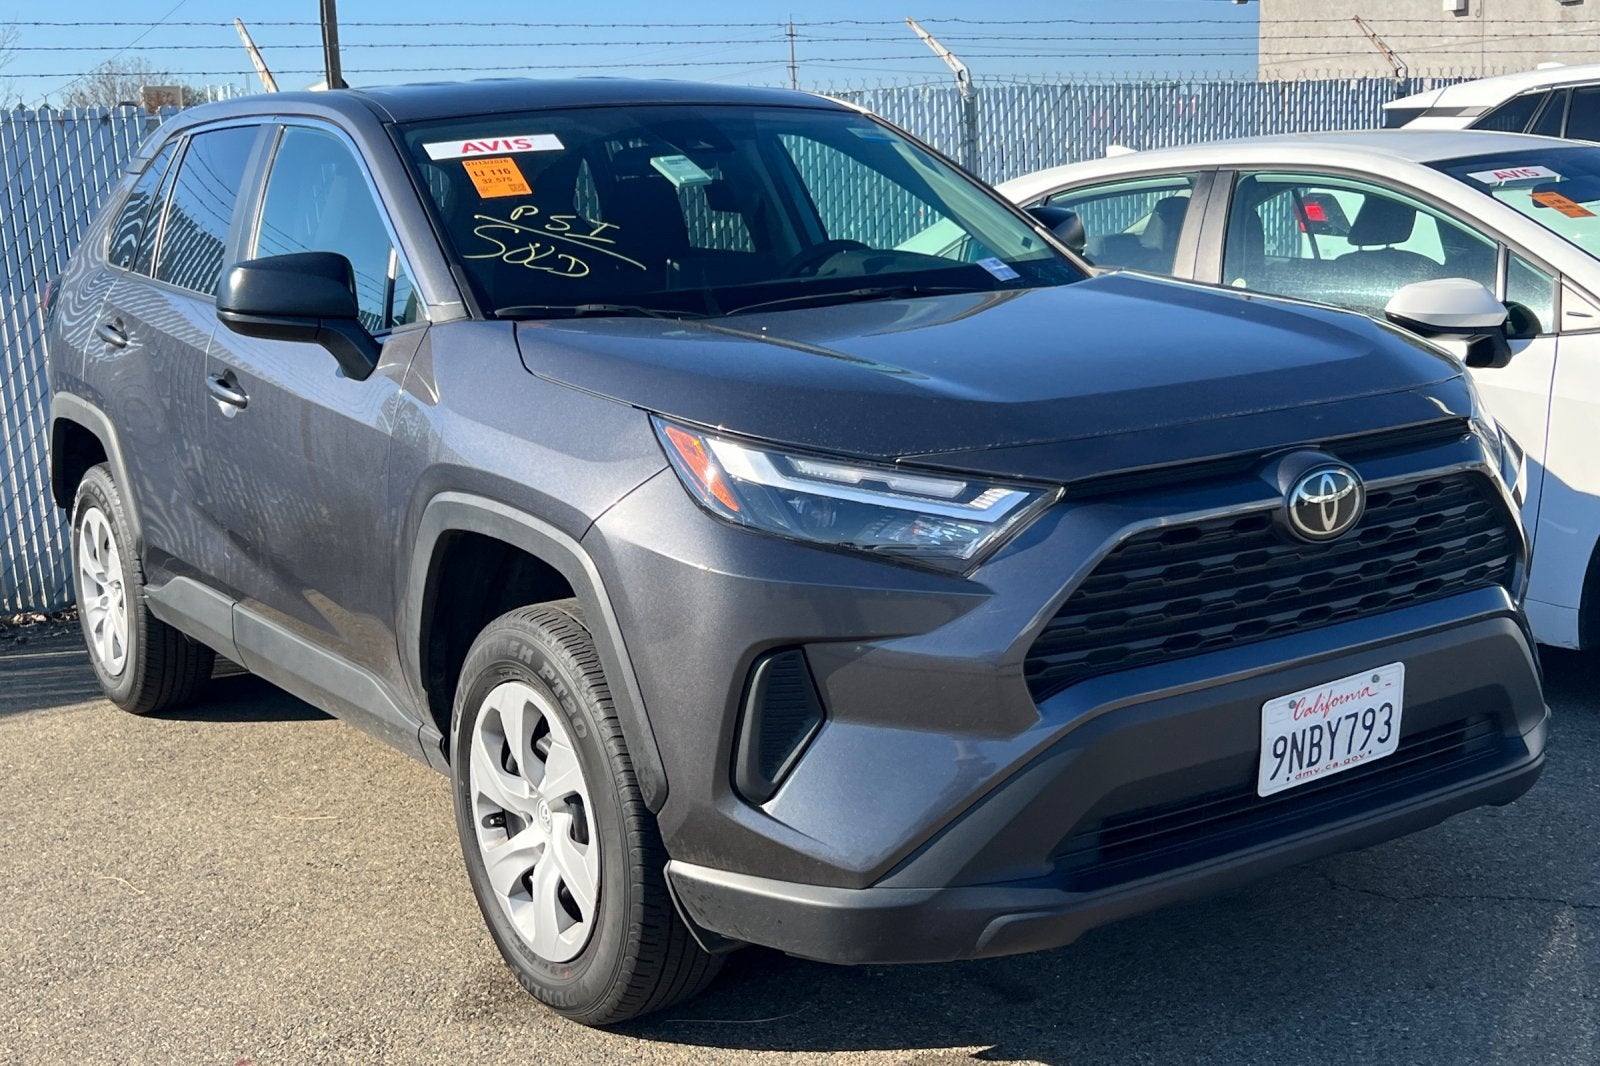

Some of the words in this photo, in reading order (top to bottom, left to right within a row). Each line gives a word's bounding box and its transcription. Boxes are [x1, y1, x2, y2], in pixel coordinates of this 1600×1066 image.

[462, 138, 532, 153] AVIS
[1493, 169, 1540, 179] AVIS
[463, 224, 590, 277] SOLD
[1294, 686, 1378, 720] California
[1269, 702, 1393, 781] 9NBY793
[1294, 752, 1366, 780] dmv.ca.gov
